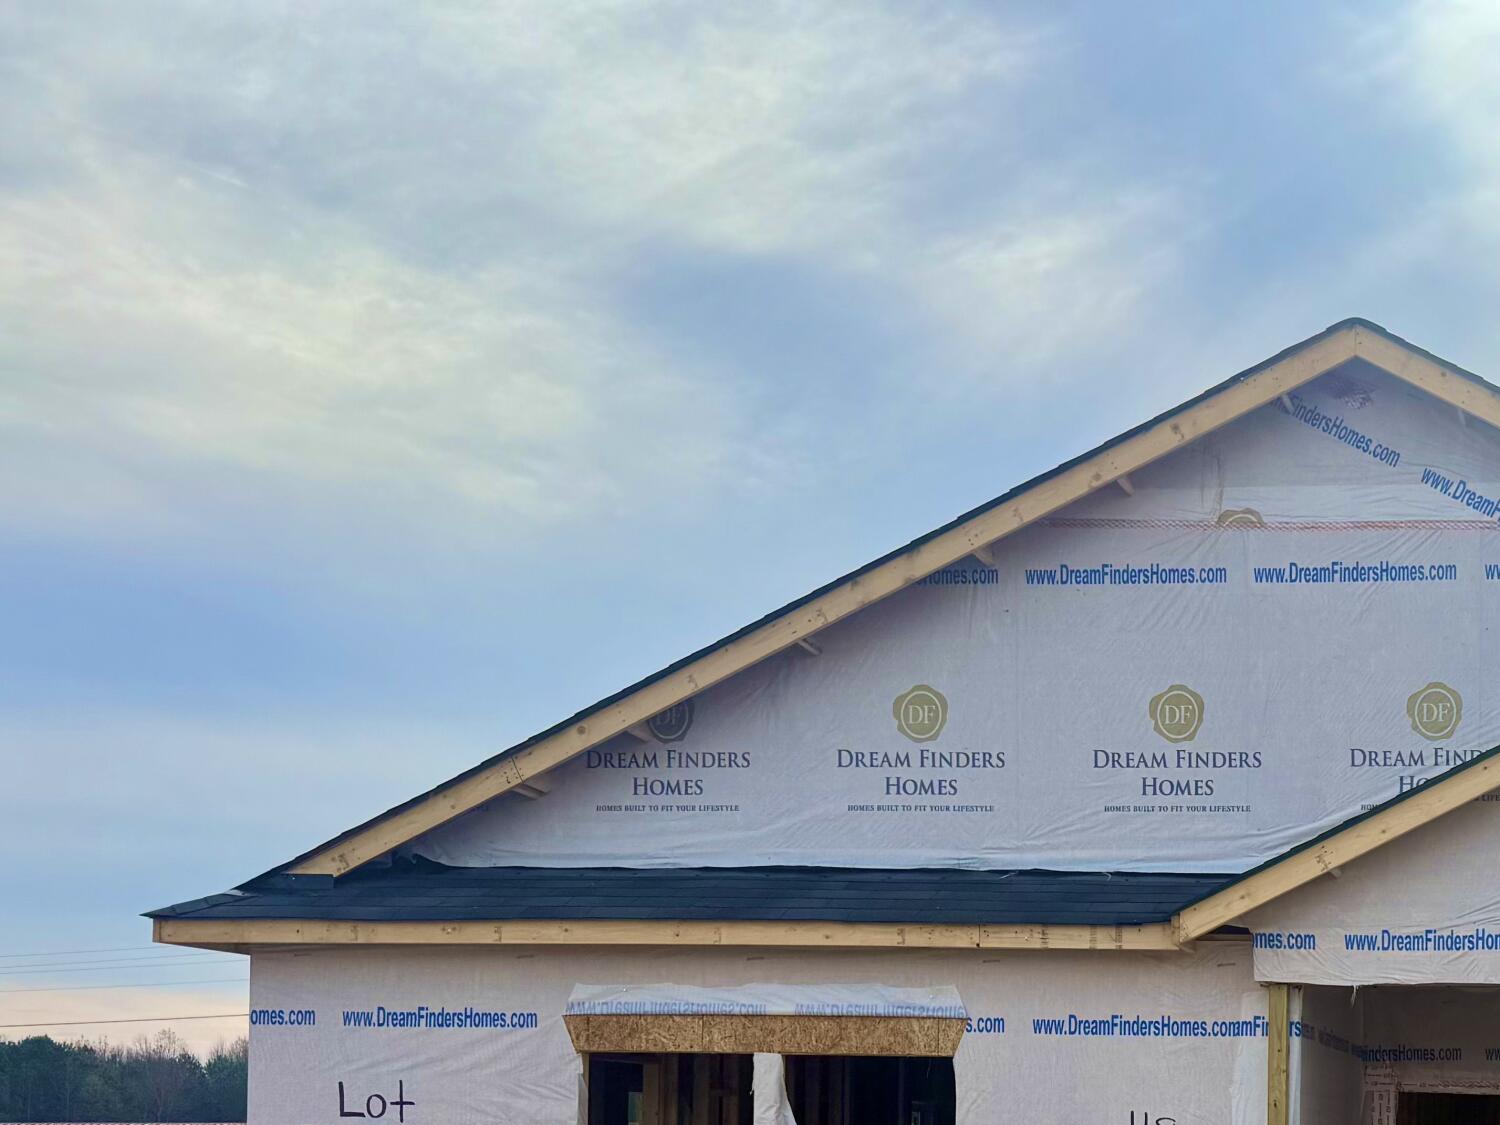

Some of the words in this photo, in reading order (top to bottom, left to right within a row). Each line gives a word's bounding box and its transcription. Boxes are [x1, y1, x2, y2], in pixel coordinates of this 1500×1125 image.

[1025, 563, 1227, 585] www.DreamFindersHomes.com
[1254, 561, 1457, 583] www.DreamFindersHomes.com
[908, 704, 936, 724] DF
[1164, 704, 1192, 724] DF
[1423, 703, 1450, 722] DF
[586, 750, 659, 769] DREAM
[666, 750, 751, 768] FINDERS
[837, 749, 912, 768] DREAM
[920, 749, 1006, 768] FINDERS
[1093, 749, 1168, 769] DREAM
[1176, 749, 1262, 768] FINDERS
[1350, 748, 1425, 767] DREAM
[633, 777, 704, 796] HOMES
[884, 776, 958, 796] HOMES
[1141, 776, 1214, 796] HOMES
[342, 1006, 538, 1029] www.DreamFindersHomes.com
[338, 1079, 415, 1123] Lot
